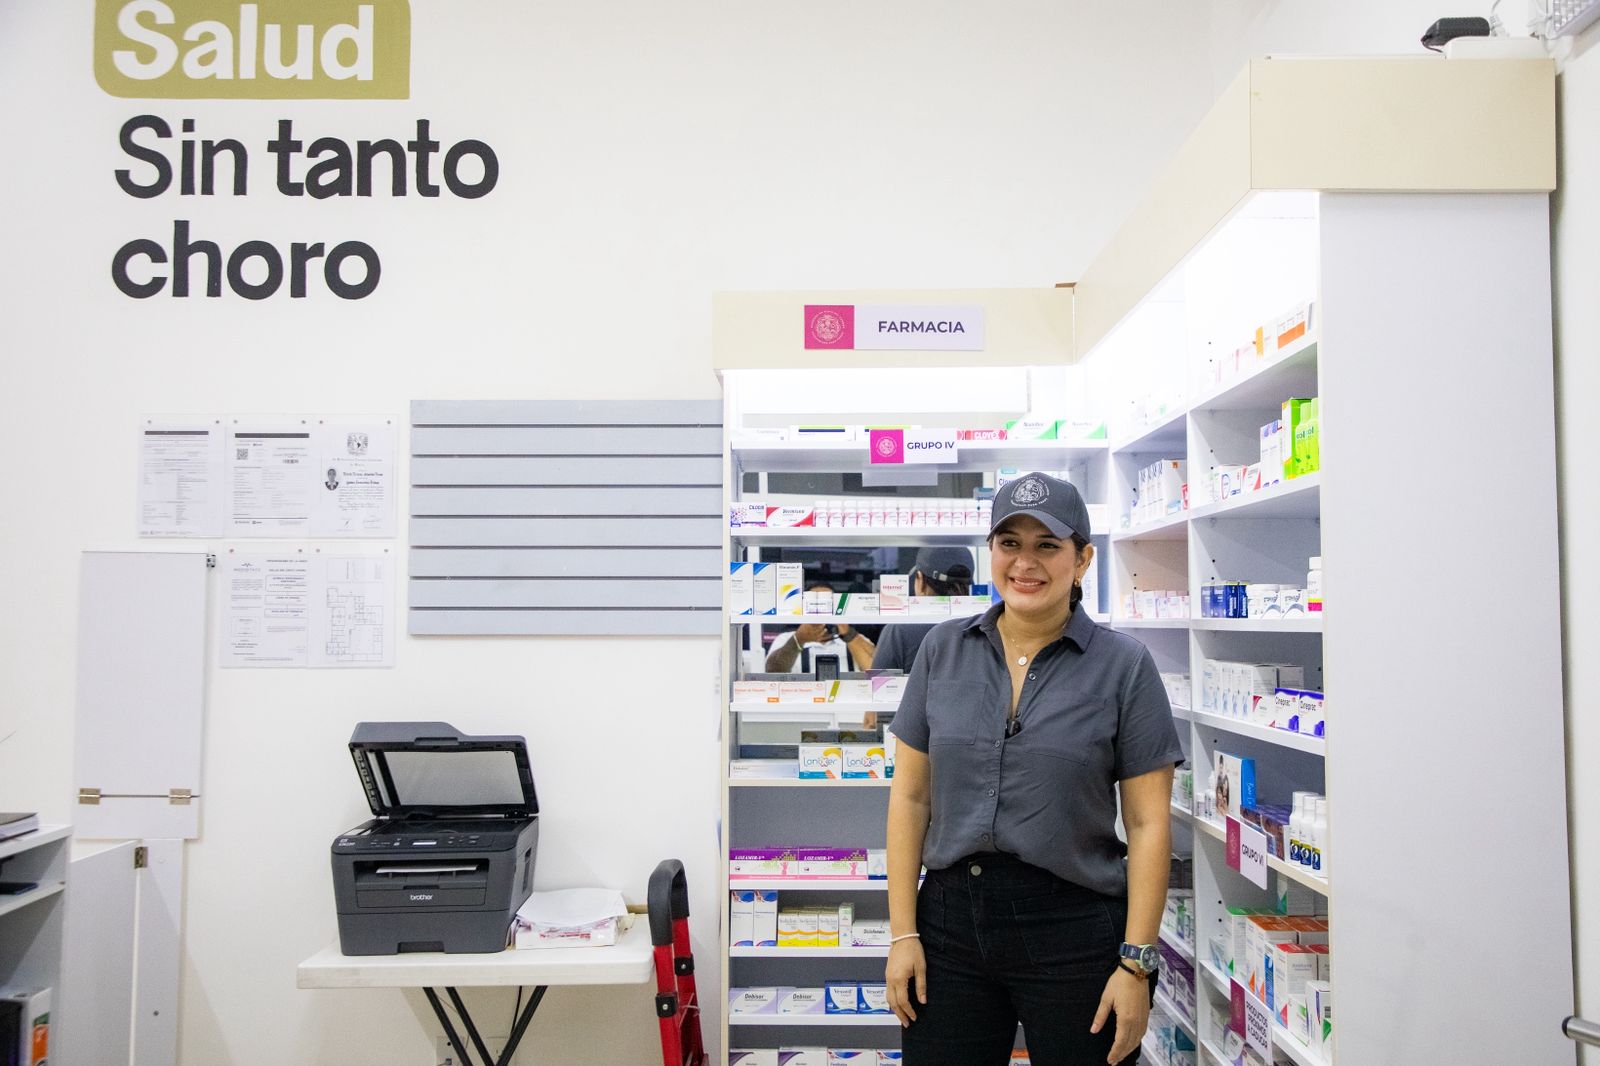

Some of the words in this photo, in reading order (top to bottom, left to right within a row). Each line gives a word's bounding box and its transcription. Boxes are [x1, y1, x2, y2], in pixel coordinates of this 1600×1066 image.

[112, 0, 374, 80] Salud
[114, 114, 248, 199] Sin
[267, 118, 499, 199] tanto
[111, 219, 381, 300] choro
[878, 321, 965, 333] FARMACIA
[907, 441, 942, 449] GRUPO
[944, 441, 954, 449] IV
[1242, 843, 1258, 863] GRUPO
